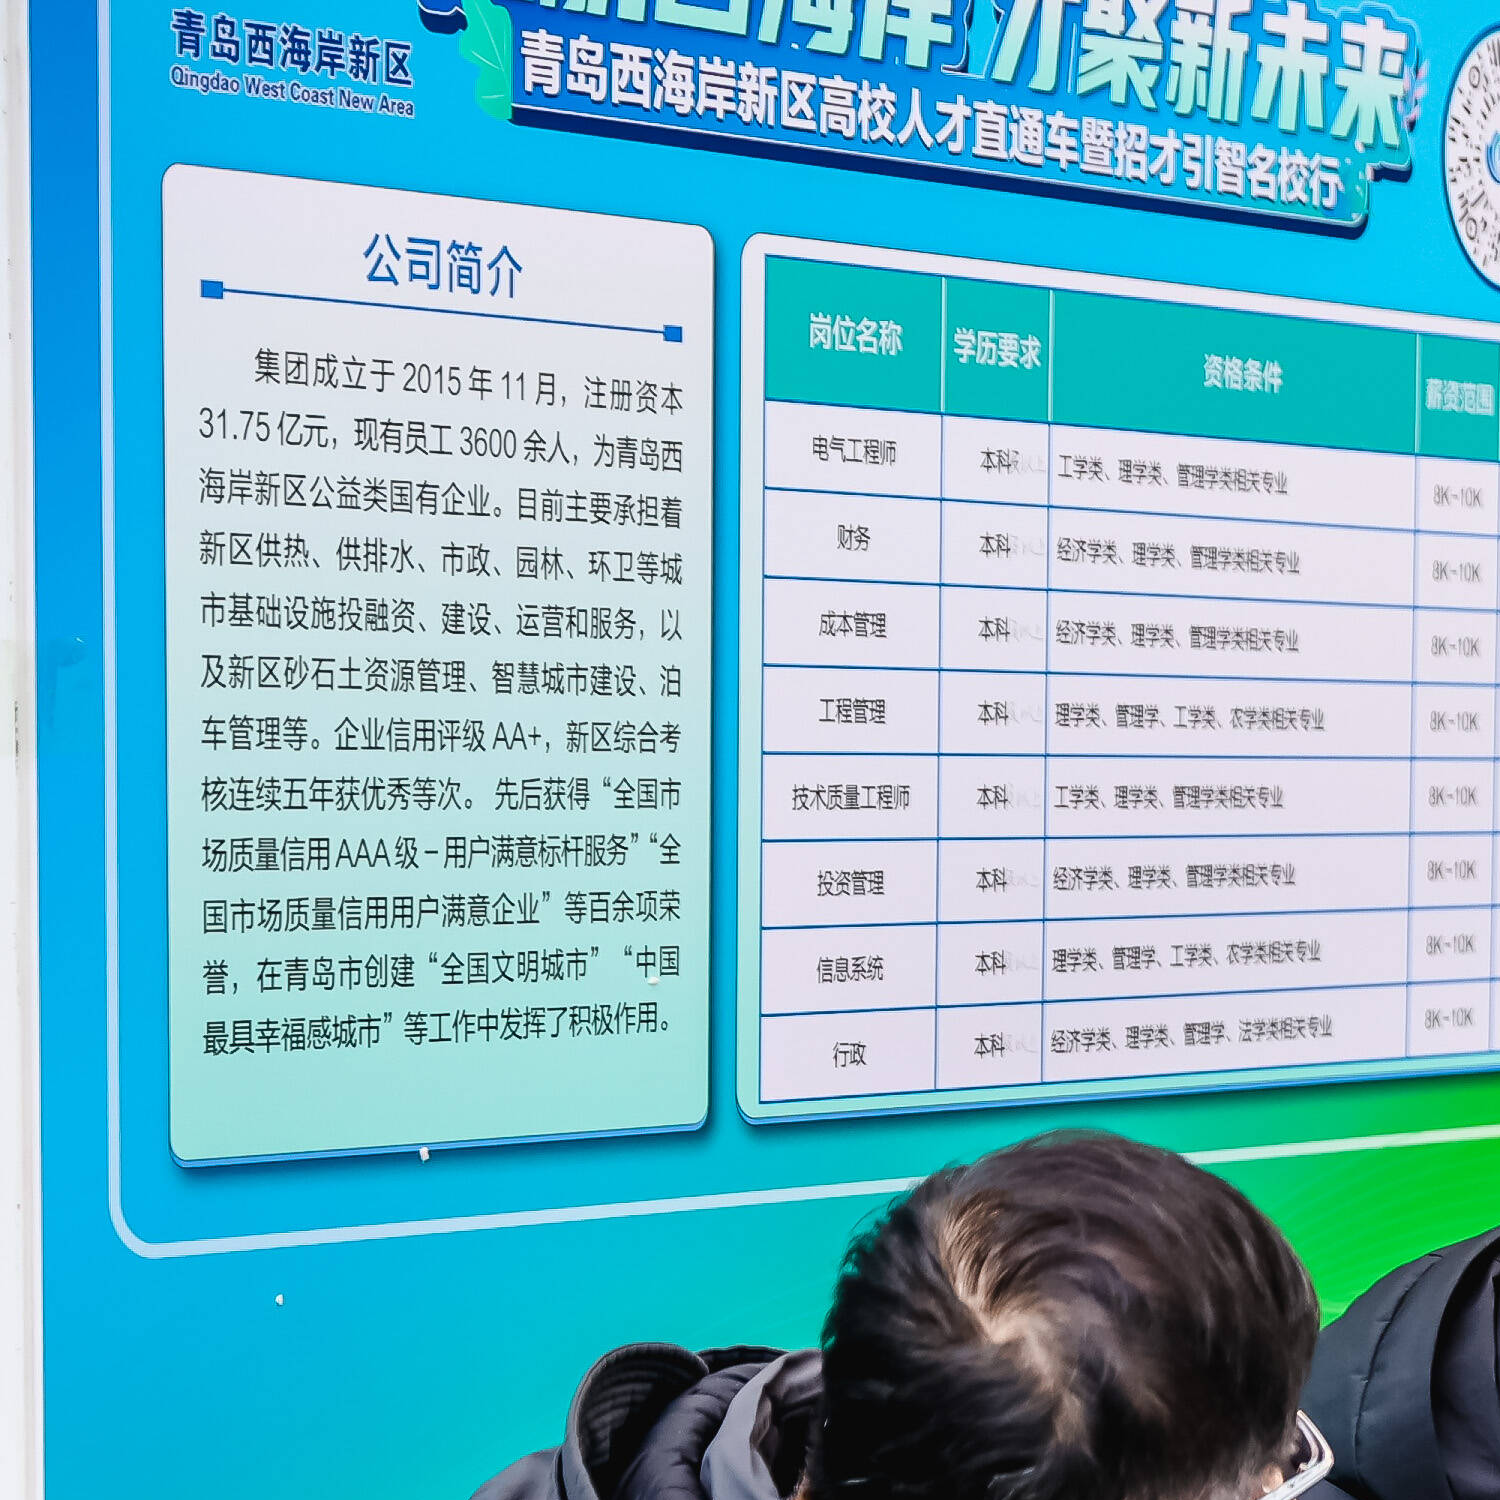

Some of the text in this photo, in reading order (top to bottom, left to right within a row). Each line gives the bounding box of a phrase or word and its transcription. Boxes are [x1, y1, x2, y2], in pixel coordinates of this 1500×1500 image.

[171, 8, 413, 87] 青岛西海岸新区
[170, 65, 414, 117] Qingdao West Coast New Area
[519, 28, 1343, 211] 青岛西海岸新区高校人才直通车暨招才引智名校行
[362, 233, 523, 298] 公司简介
[808, 311, 904, 356] 岗位名称
[953, 327, 1042, 370] 学历要求
[1203, 353, 1284, 394] 资格条件
[812, 434, 898, 467] 电气工程师
[198, 466, 684, 530] 海岸新区公益类国有企业。目前主要承担着
[198, 528, 684, 586] 新区供热、供排水、市政、园林、环卫等城
[836, 523, 872, 552] 财务
[199, 590, 683, 642] 市基础设施投融资、建设、运营和服务，以
[818, 609, 888, 639] 成本管理
[200, 652, 682, 698] 及新区砂石土资源管理、智慧城市建设、泊
[818, 696, 887, 725] 工程管理
[791, 783, 911, 811] 技术质量工程师
[816, 868, 886, 897] 投资管理
[815, 954, 885, 984] 信息系统
[201, 1001, 671, 1057] 最具幸福感城市”等工作中发挥了积极作用。
[832, 1040, 868, 1069] 行政
